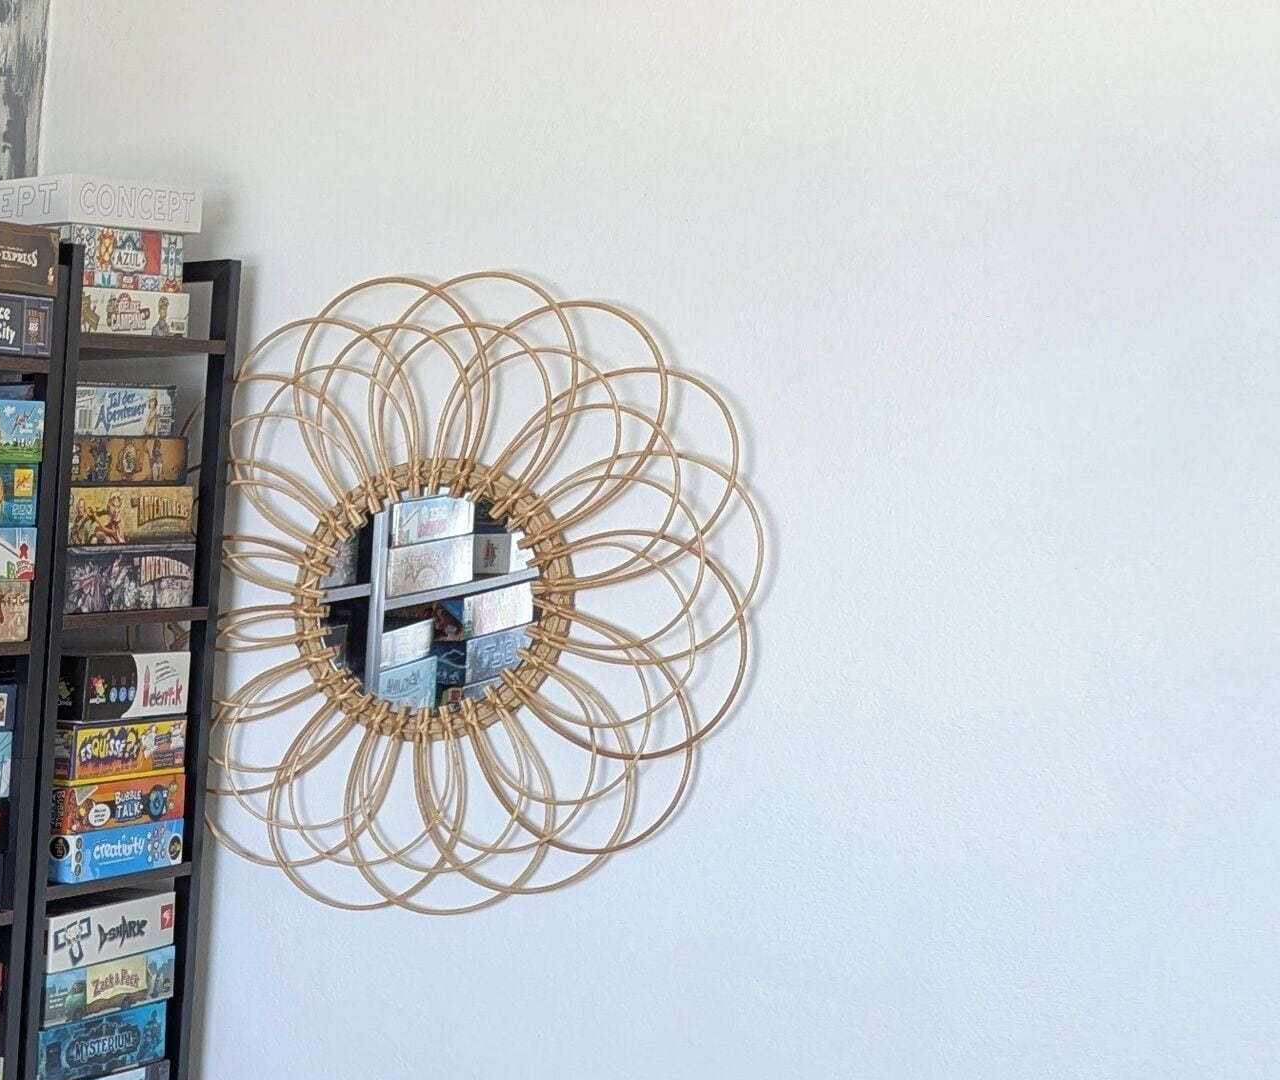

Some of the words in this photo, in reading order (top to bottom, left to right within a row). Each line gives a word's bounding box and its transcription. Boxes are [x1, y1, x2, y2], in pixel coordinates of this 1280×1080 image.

[80, 182, 197, 224] CONCEPT
[115, 251, 141, 267] AZUL
[114, 789, 142, 803] BUBBLE
[115, 801, 142, 820] TALK
[93, 832, 147, 861] creativity
[73, 1030, 135, 1063] MYSTERIUM
